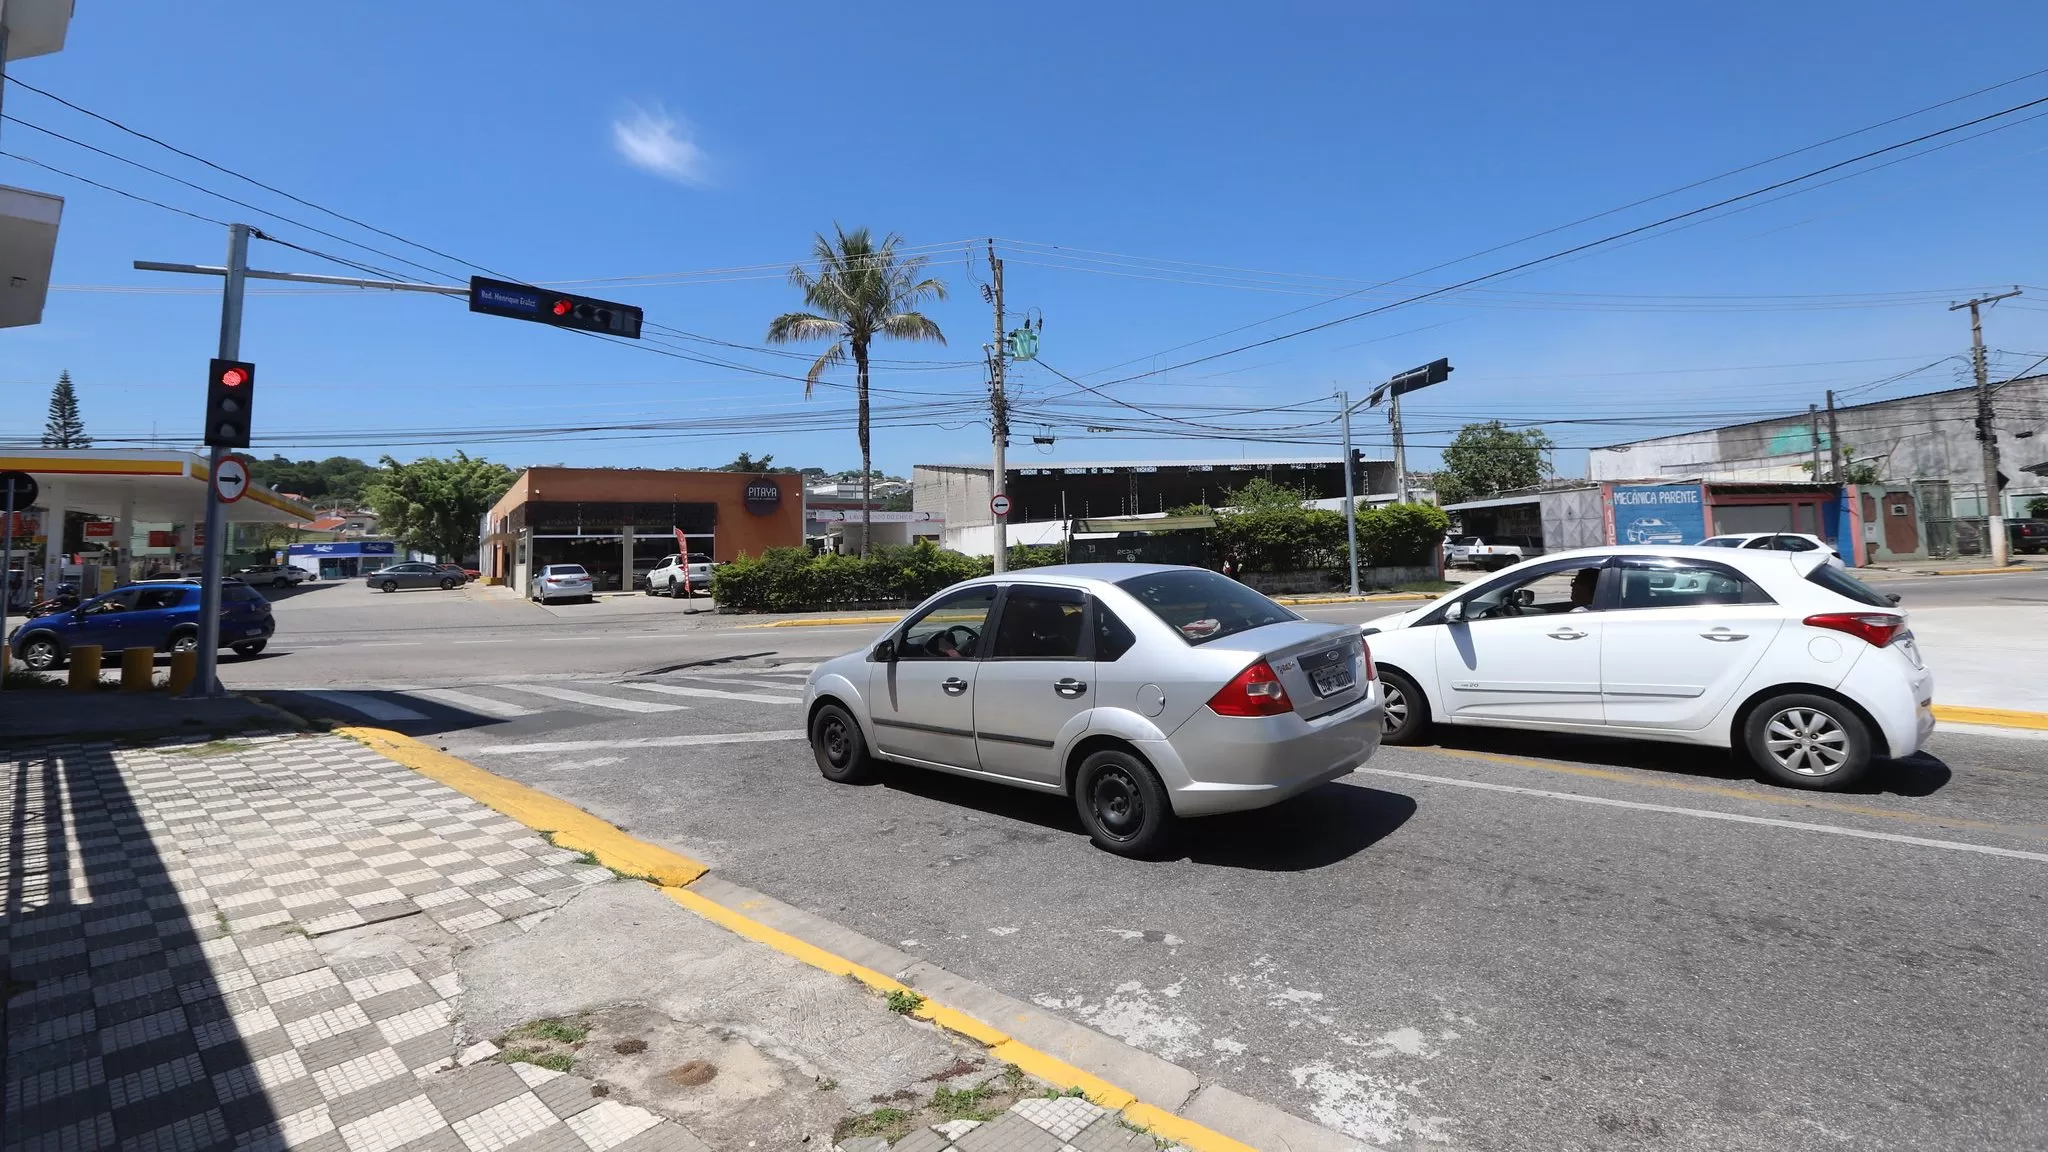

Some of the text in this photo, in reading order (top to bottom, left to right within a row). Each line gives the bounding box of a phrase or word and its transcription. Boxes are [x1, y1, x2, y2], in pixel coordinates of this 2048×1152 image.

[748, 487, 777, 497] PITAYA
[1613, 489, 1698, 505] MECÂNICA PARENTE
